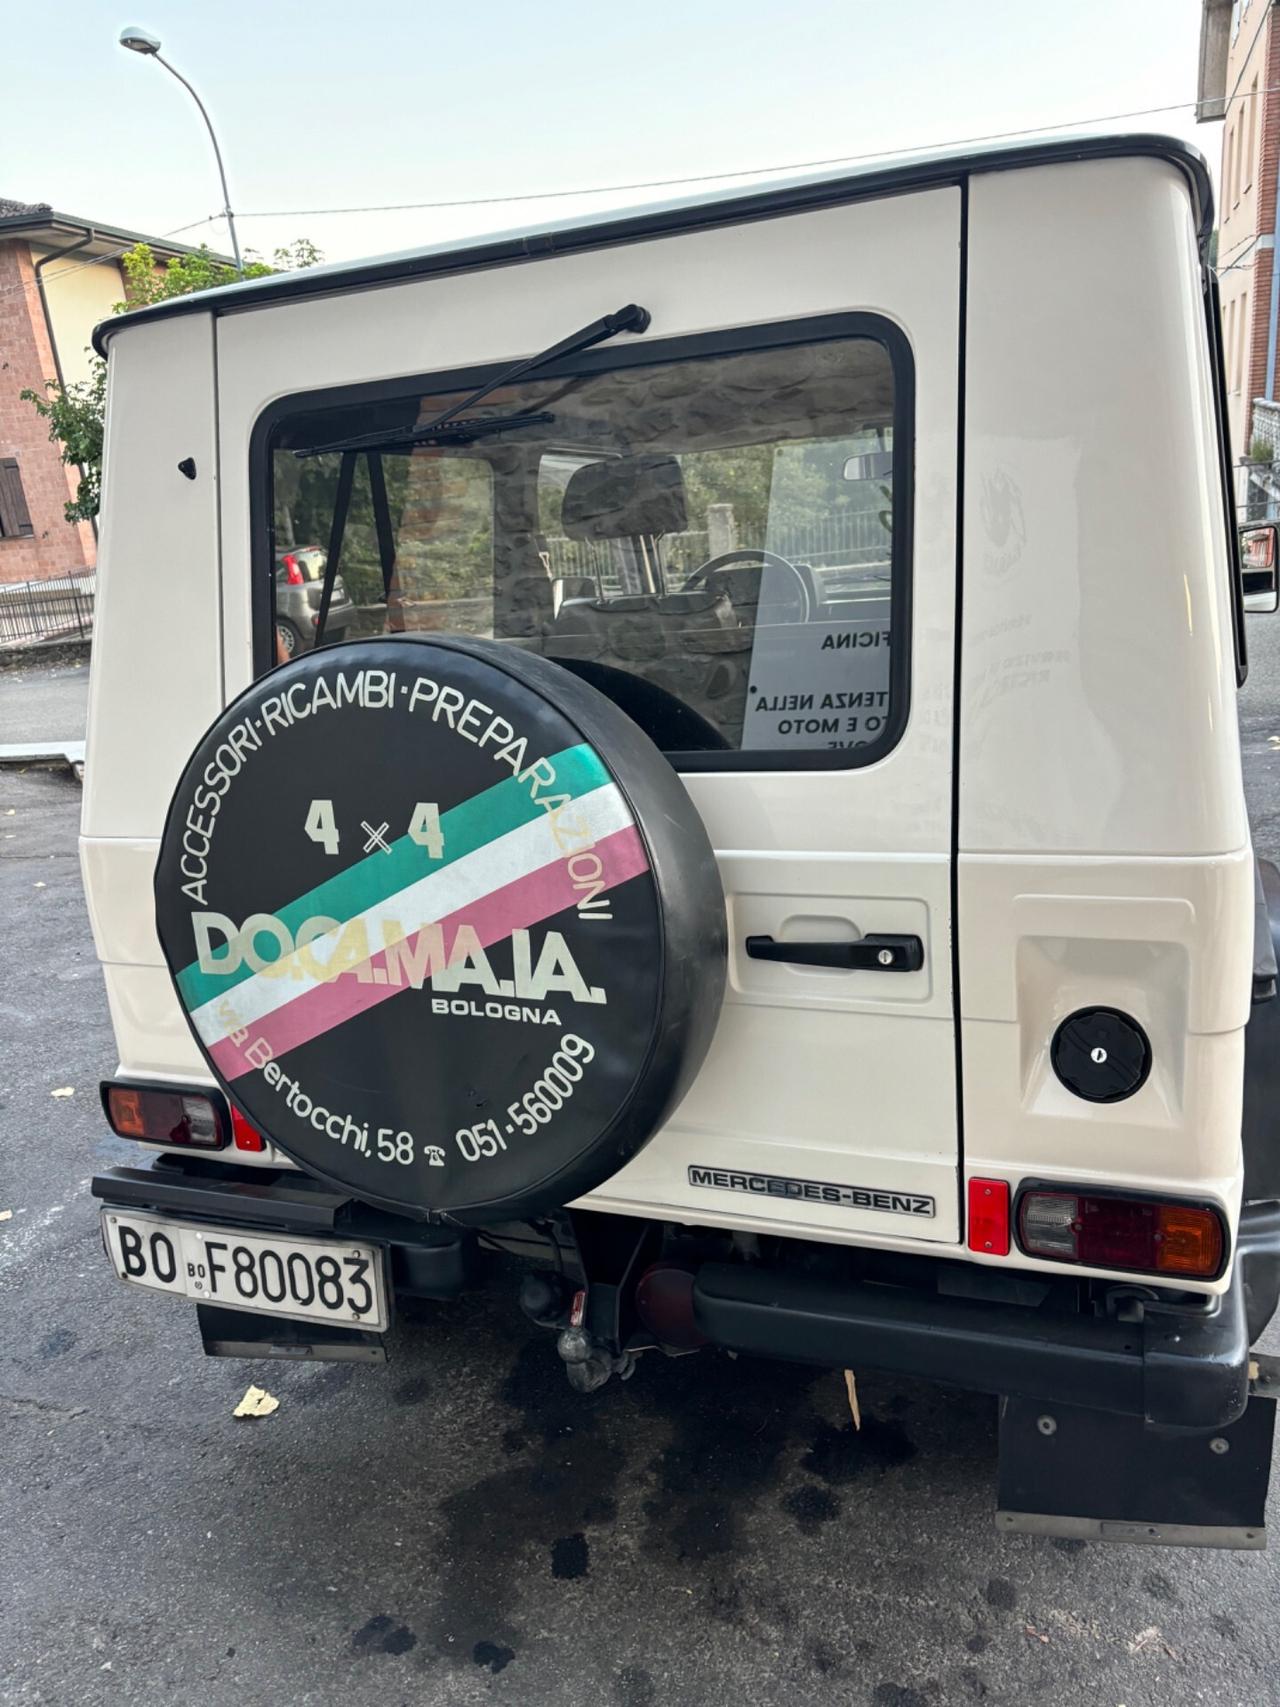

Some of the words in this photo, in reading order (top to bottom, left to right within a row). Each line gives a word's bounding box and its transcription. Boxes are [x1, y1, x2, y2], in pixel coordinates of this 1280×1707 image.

[431, 998, 563, 1026] BOLOGNA
[691, 1169, 932, 1215] MERCEDES-BENZ
[118, 1225, 177, 1283] BO
[187, 1262, 206, 1278] BO
[204, 1241, 372, 1315] F80083
